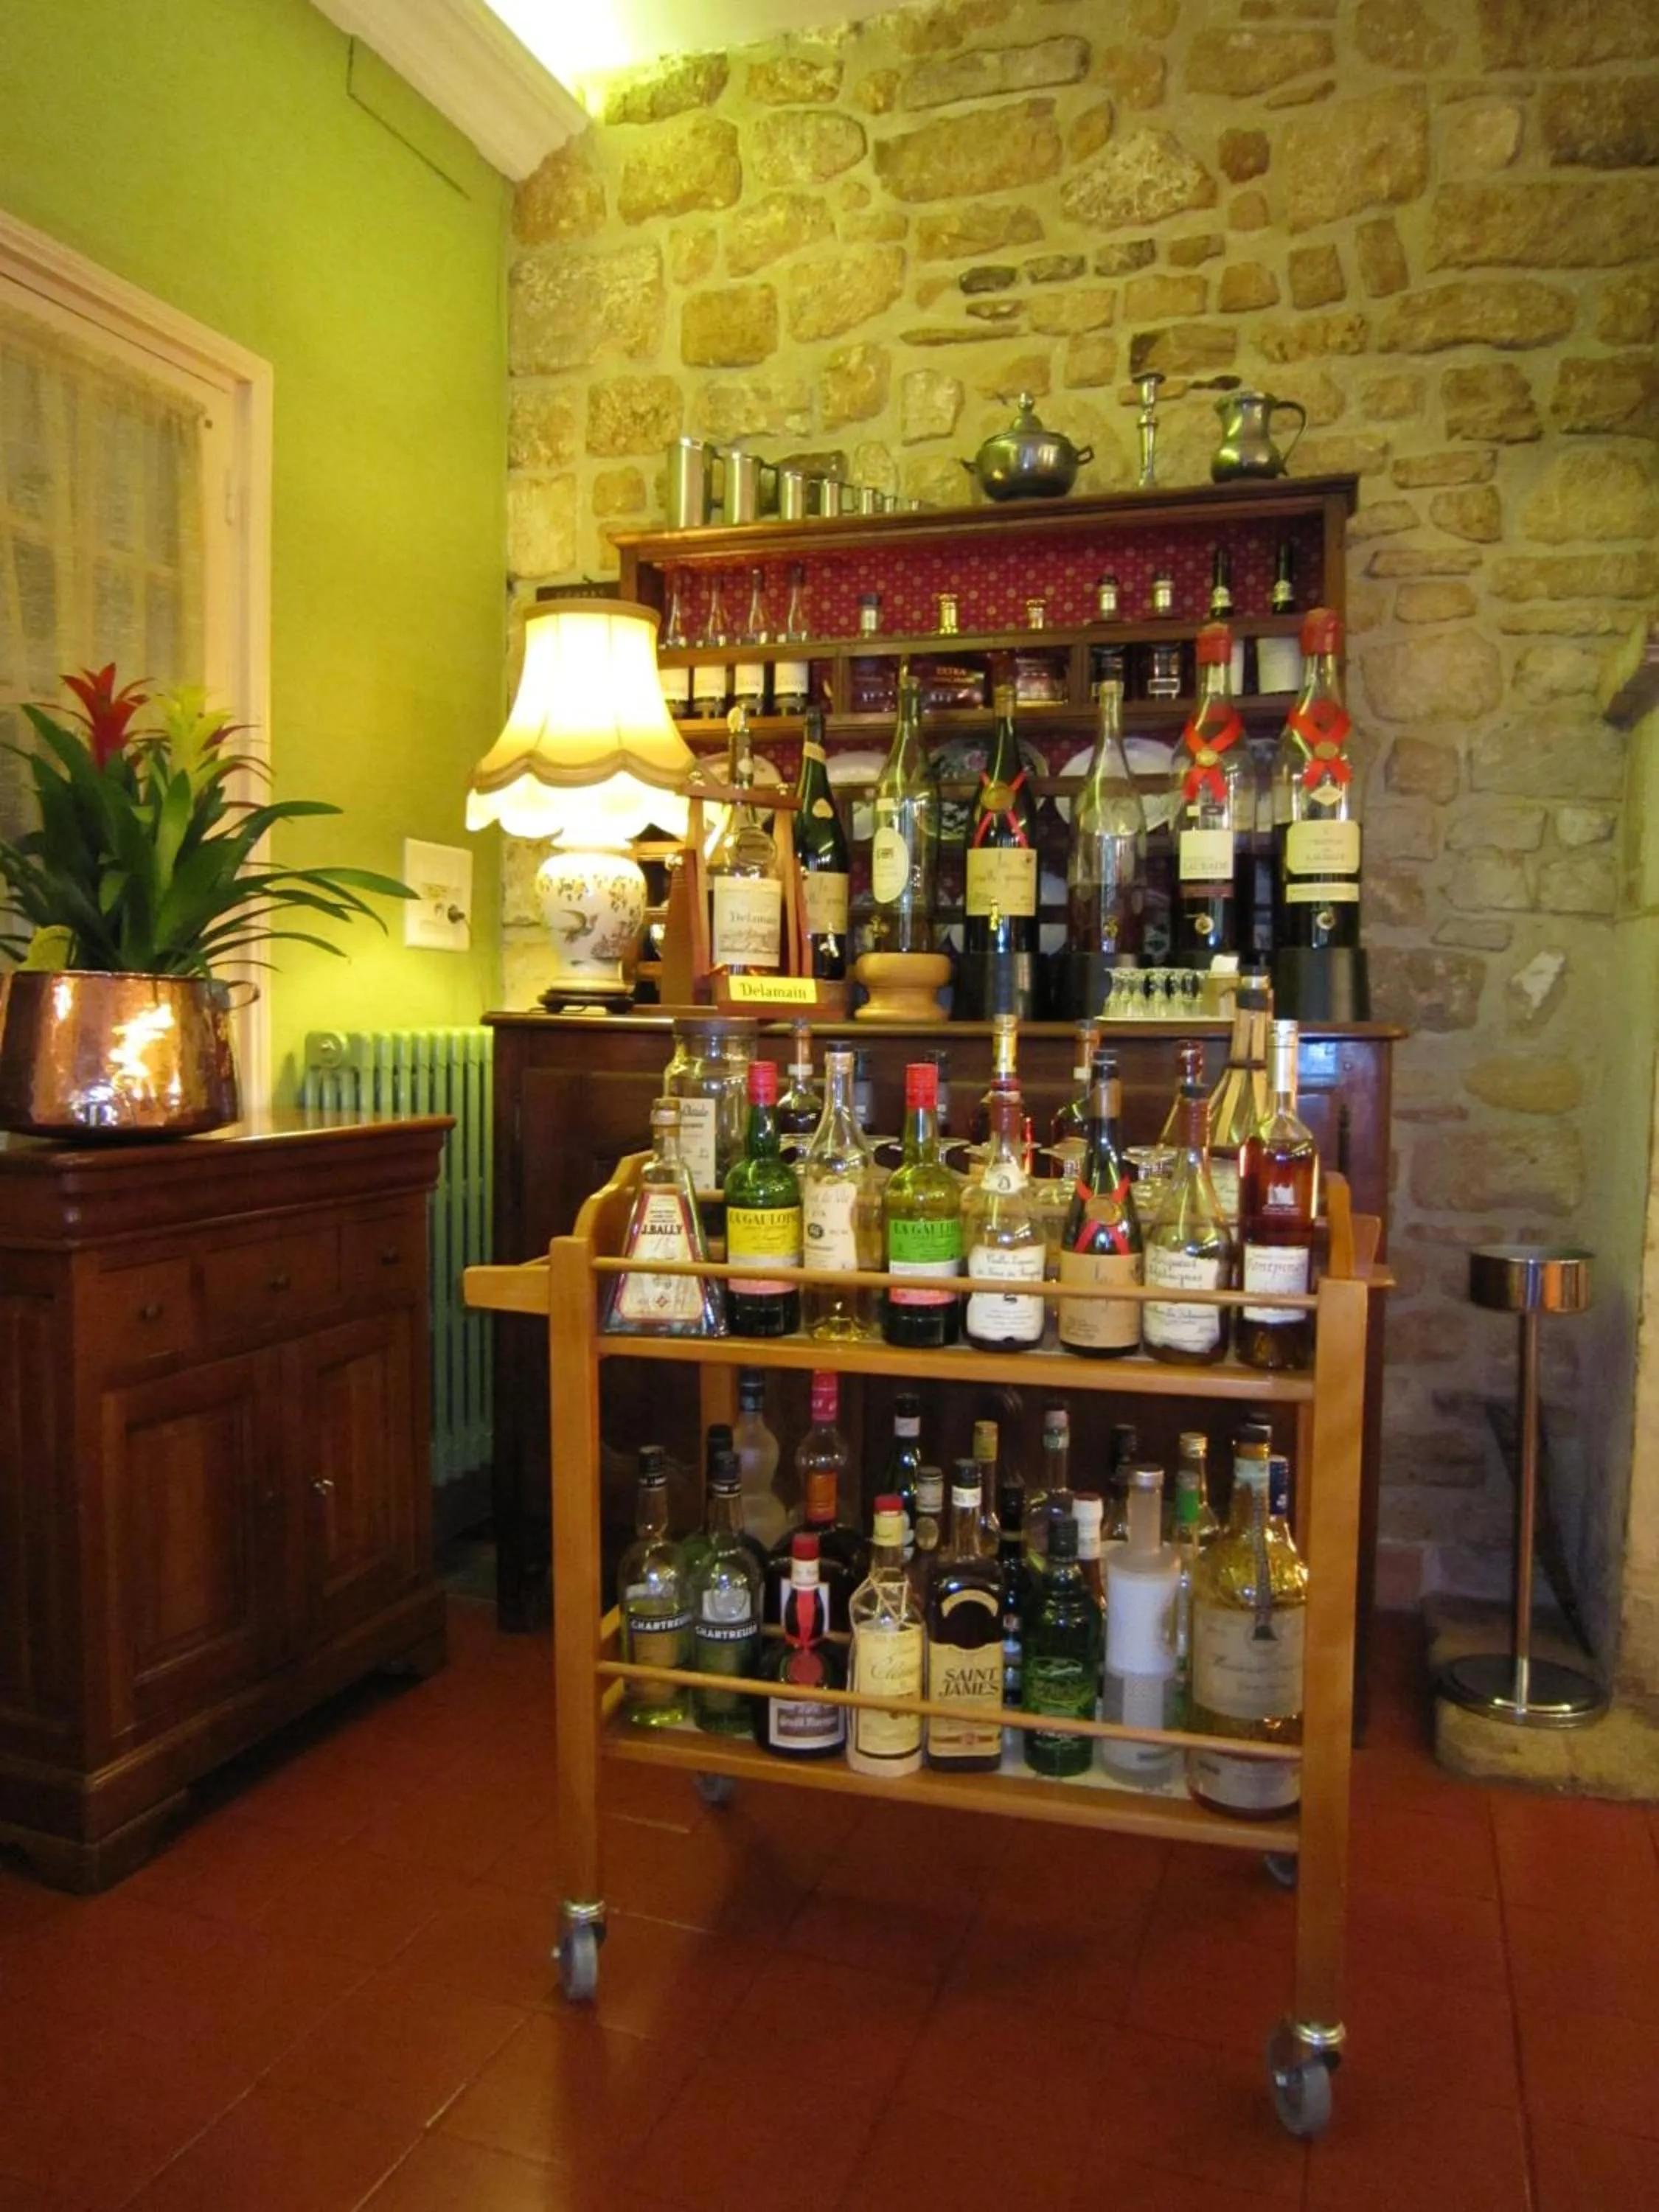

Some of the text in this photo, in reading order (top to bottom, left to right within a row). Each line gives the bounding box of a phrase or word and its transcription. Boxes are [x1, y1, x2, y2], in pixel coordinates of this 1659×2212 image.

[740, 981, 807, 999] Delamain
[641, 1224, 683, 1235] J.BALLY
[945, 1667, 998, 1681] SAINT
[938, 1680, 1000, 1697] JAMES
